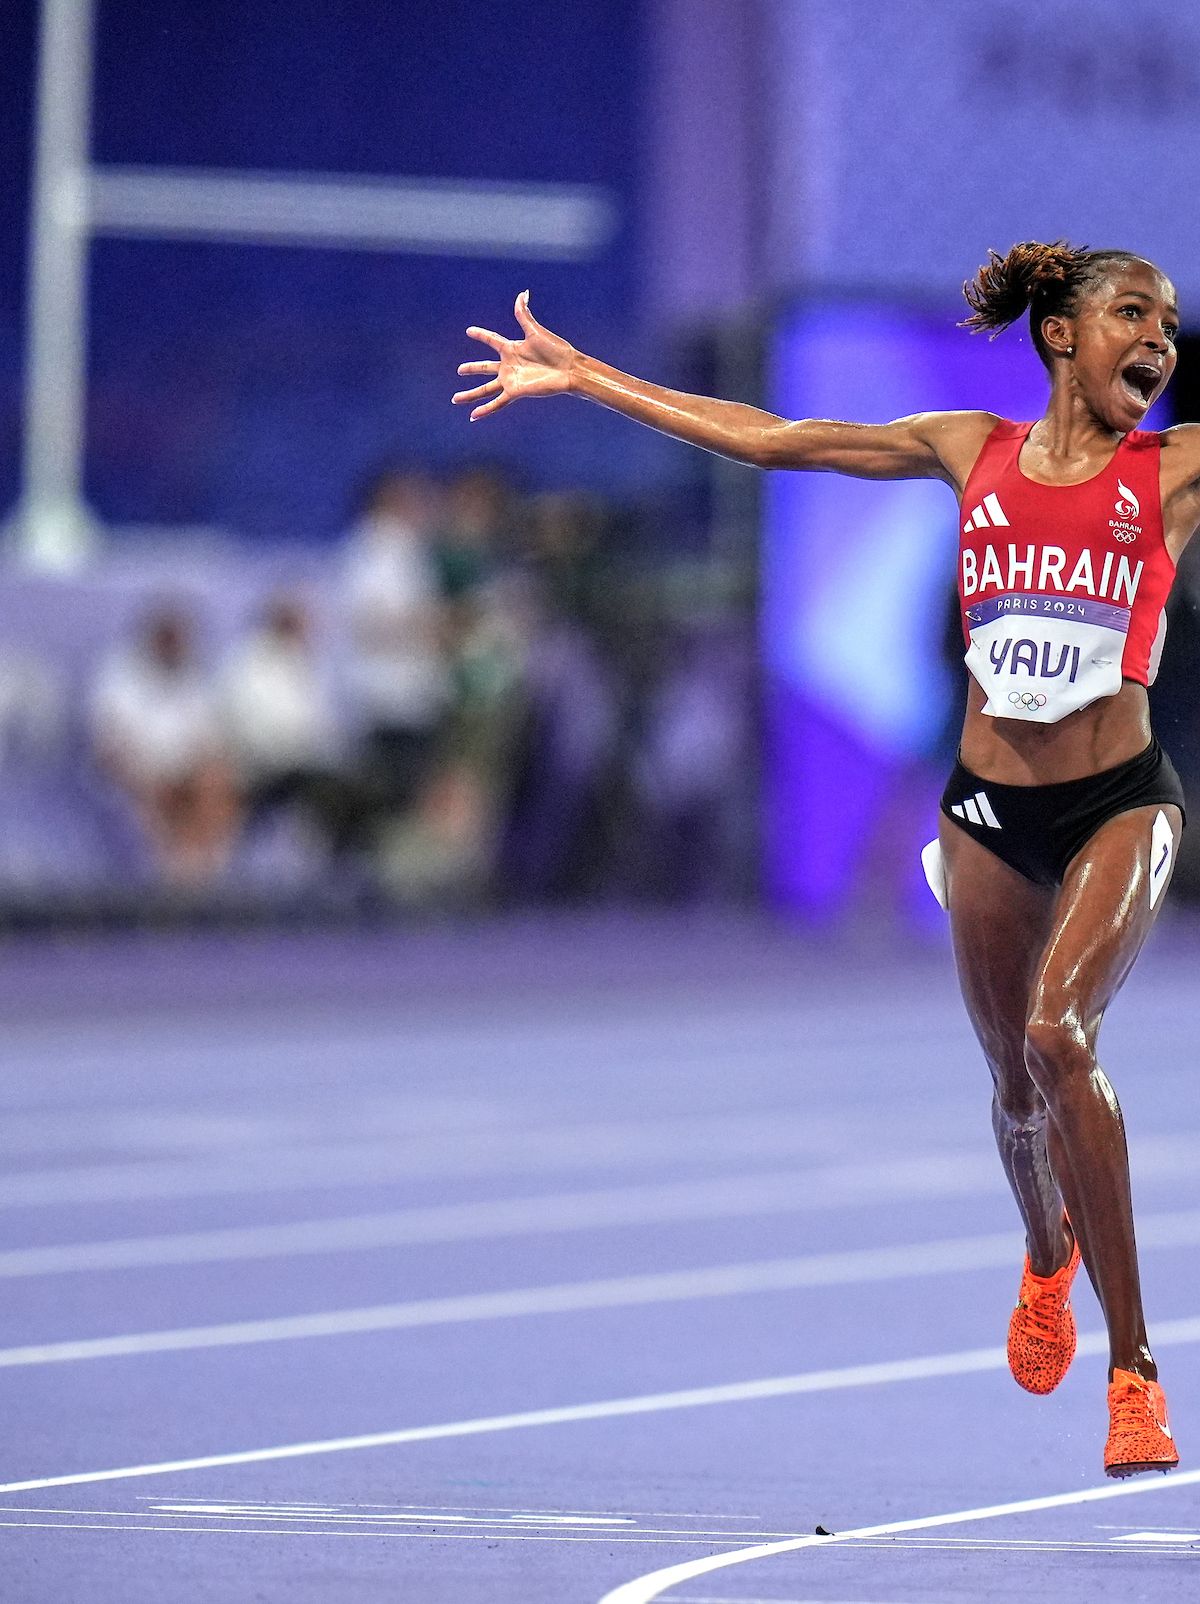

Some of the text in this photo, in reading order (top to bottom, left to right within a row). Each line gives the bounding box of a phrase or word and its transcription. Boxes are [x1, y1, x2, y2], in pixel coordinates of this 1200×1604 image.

[1108, 519, 1143, 534] BAHRAIN
[962, 543, 1144, 606] BAHRAIN
[997, 598, 1086, 616] PARIS 2024
[989, 638, 1080, 683] YAVI
